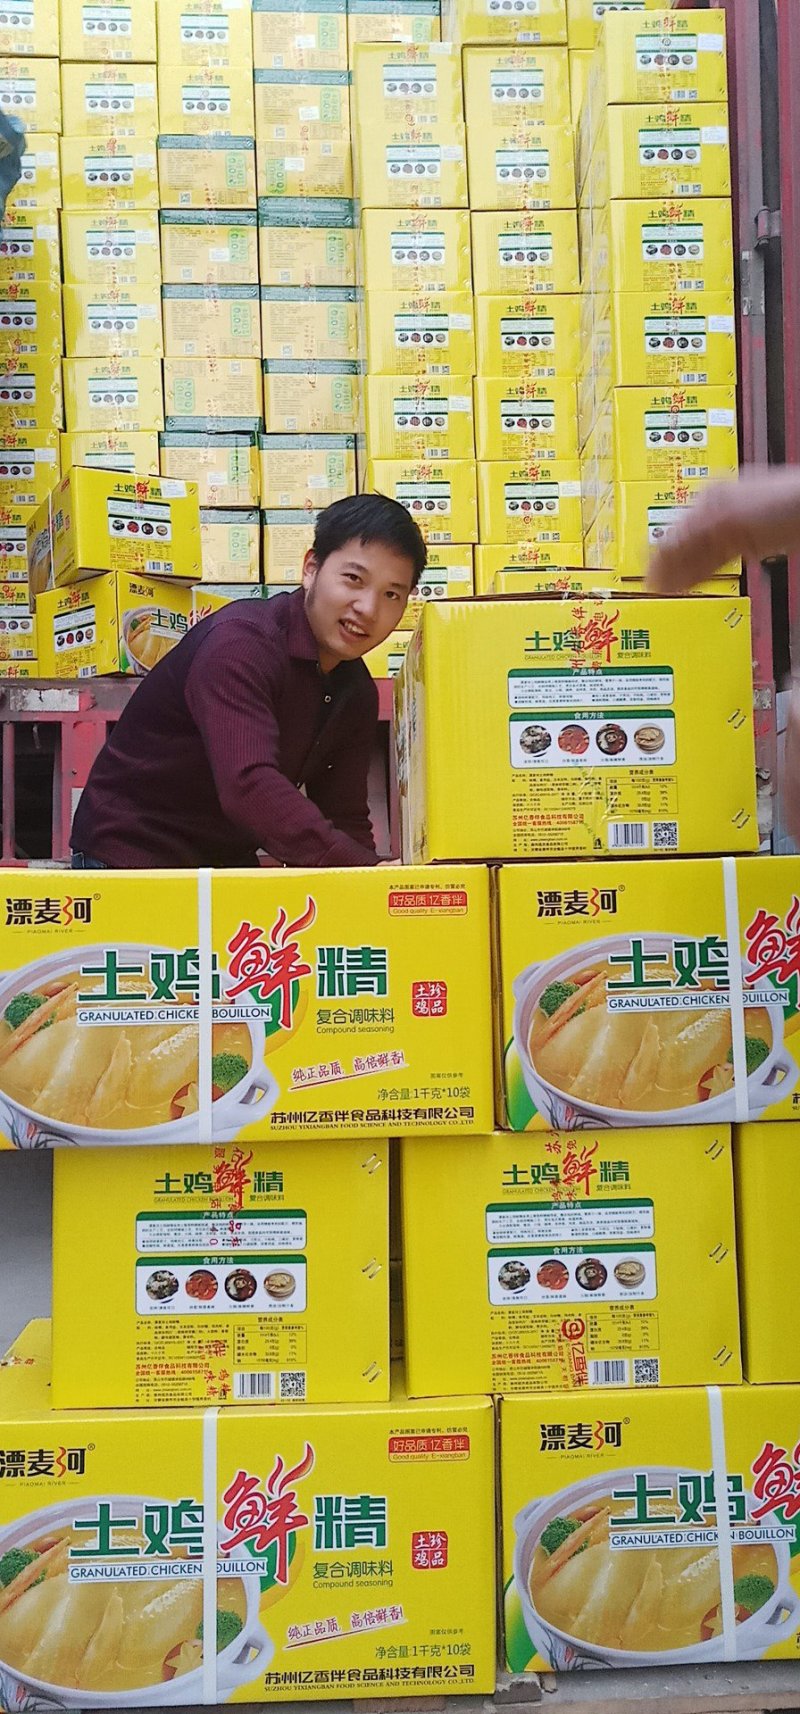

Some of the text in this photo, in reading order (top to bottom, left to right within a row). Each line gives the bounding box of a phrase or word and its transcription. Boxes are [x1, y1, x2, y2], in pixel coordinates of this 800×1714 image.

[393, 894, 463, 906] 好品质 亿香伴
[78, 896, 388, 1028] 土鸡鲜精
[609, 992, 788, 1008] GRANULATED CHICKEN OUILLON
[79, 1007, 270, 1022] GRANULATED CHICKE BOUILLON
[316, 1008, 395, 1025] 复合调味料
[316, 1025, 395, 1034] Compound seasoning
[270, 1106, 475, 1124] 苏州亿香伴食品科技有限公司
[393, 1438, 465, 1452] 好品质 亿香伴
[70, 1443, 386, 1583] 土鸡鲜精
[612, 1528, 794, 1545] GRANULATED CHICKN BOUILLON
[70, 1561, 265, 1579] GRANULATED CHICKEN OUILLON
[313, 1560, 394, 1579] 复合调味料
[313, 1578, 394, 1589] Compound seasoning
[265, 1664, 475, 1685] 苏州亿香伴食品科技有限公司
[401, 1679, 446, 1687] TECHNOLOGY
